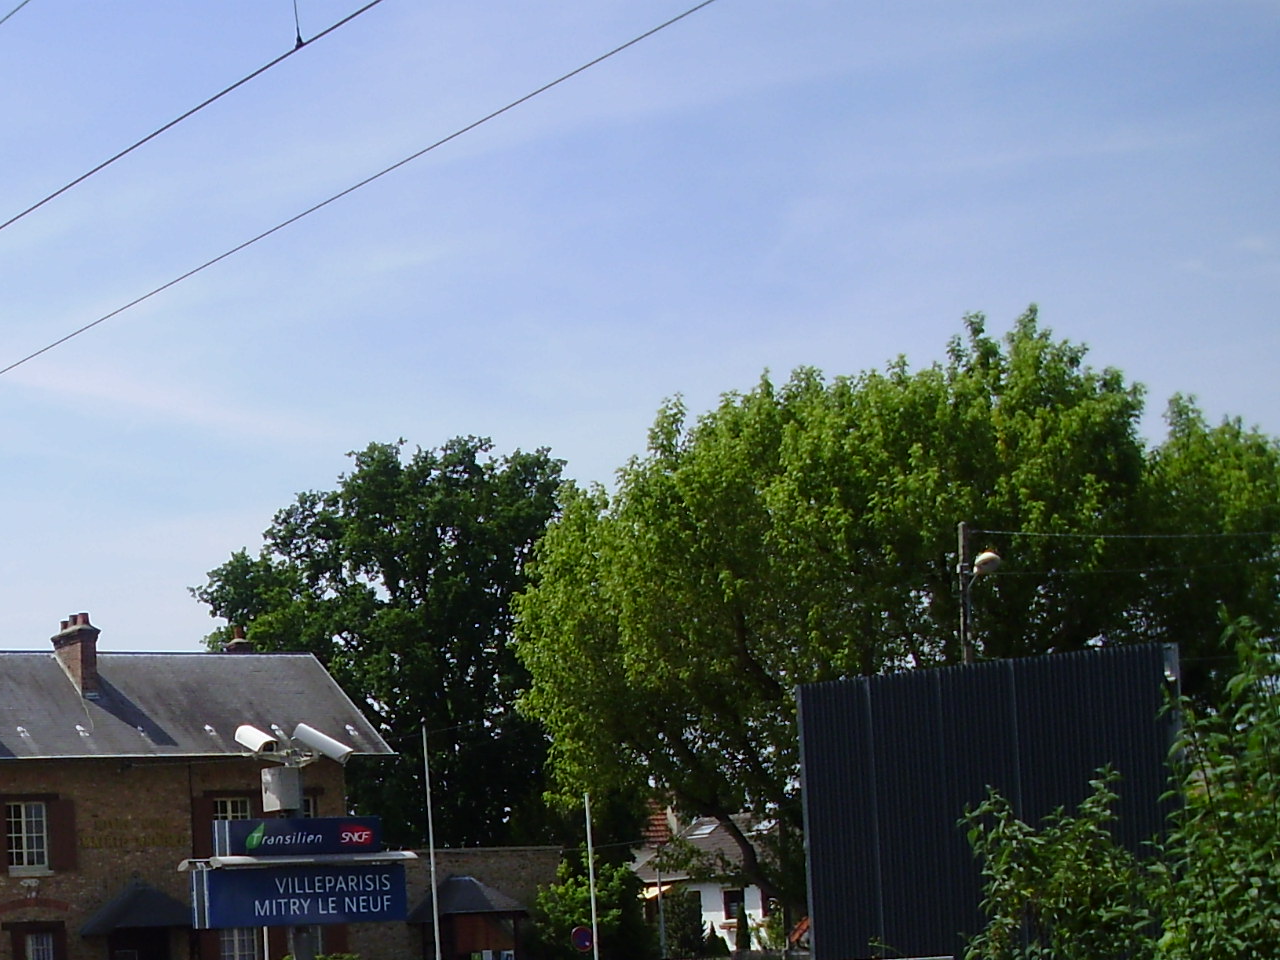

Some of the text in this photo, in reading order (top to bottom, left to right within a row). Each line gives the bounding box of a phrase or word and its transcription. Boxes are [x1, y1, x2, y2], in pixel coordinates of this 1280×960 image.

[251, 831, 323, 845] Transilien
[340, 831, 371, 844] SNCF
[275, 874, 391, 894] VILLEPARISIS
[254, 895, 391, 917] MITRY LE NEUF
